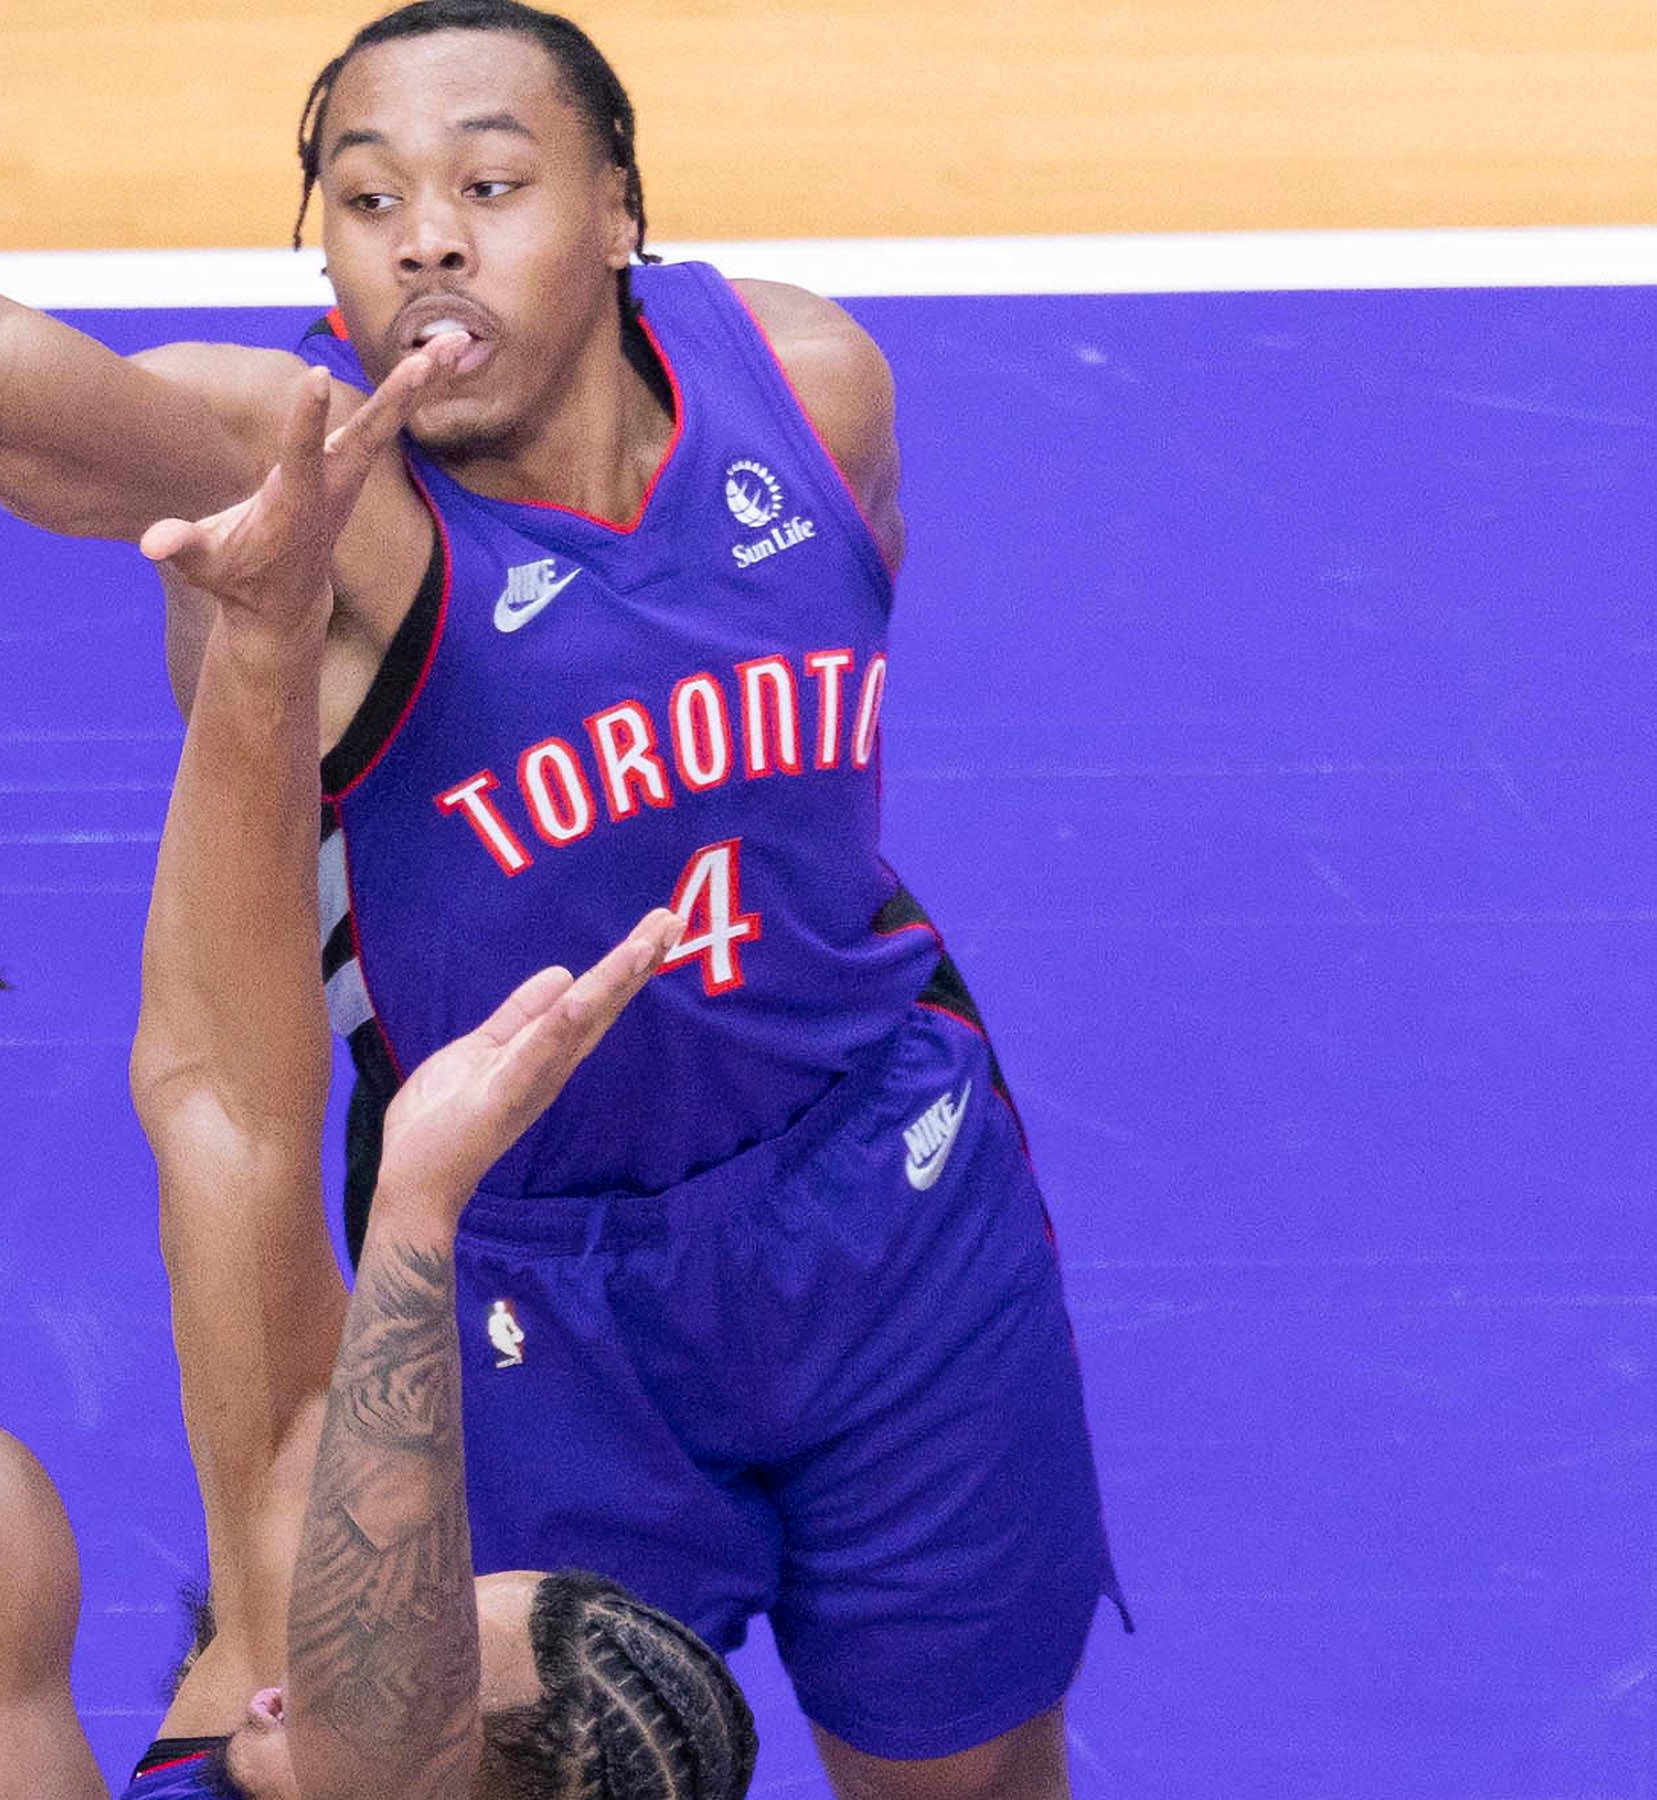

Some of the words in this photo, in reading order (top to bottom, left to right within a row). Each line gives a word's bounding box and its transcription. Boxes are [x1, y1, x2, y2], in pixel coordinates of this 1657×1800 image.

[731, 537, 777, 569] Sun
[770, 515, 817, 551] Life
[507, 558, 556, 604] NIKE
[433, 648, 887, 878] TORONTO
[654, 836, 762, 998] 4
[902, 1091, 956, 1165] NIKE
